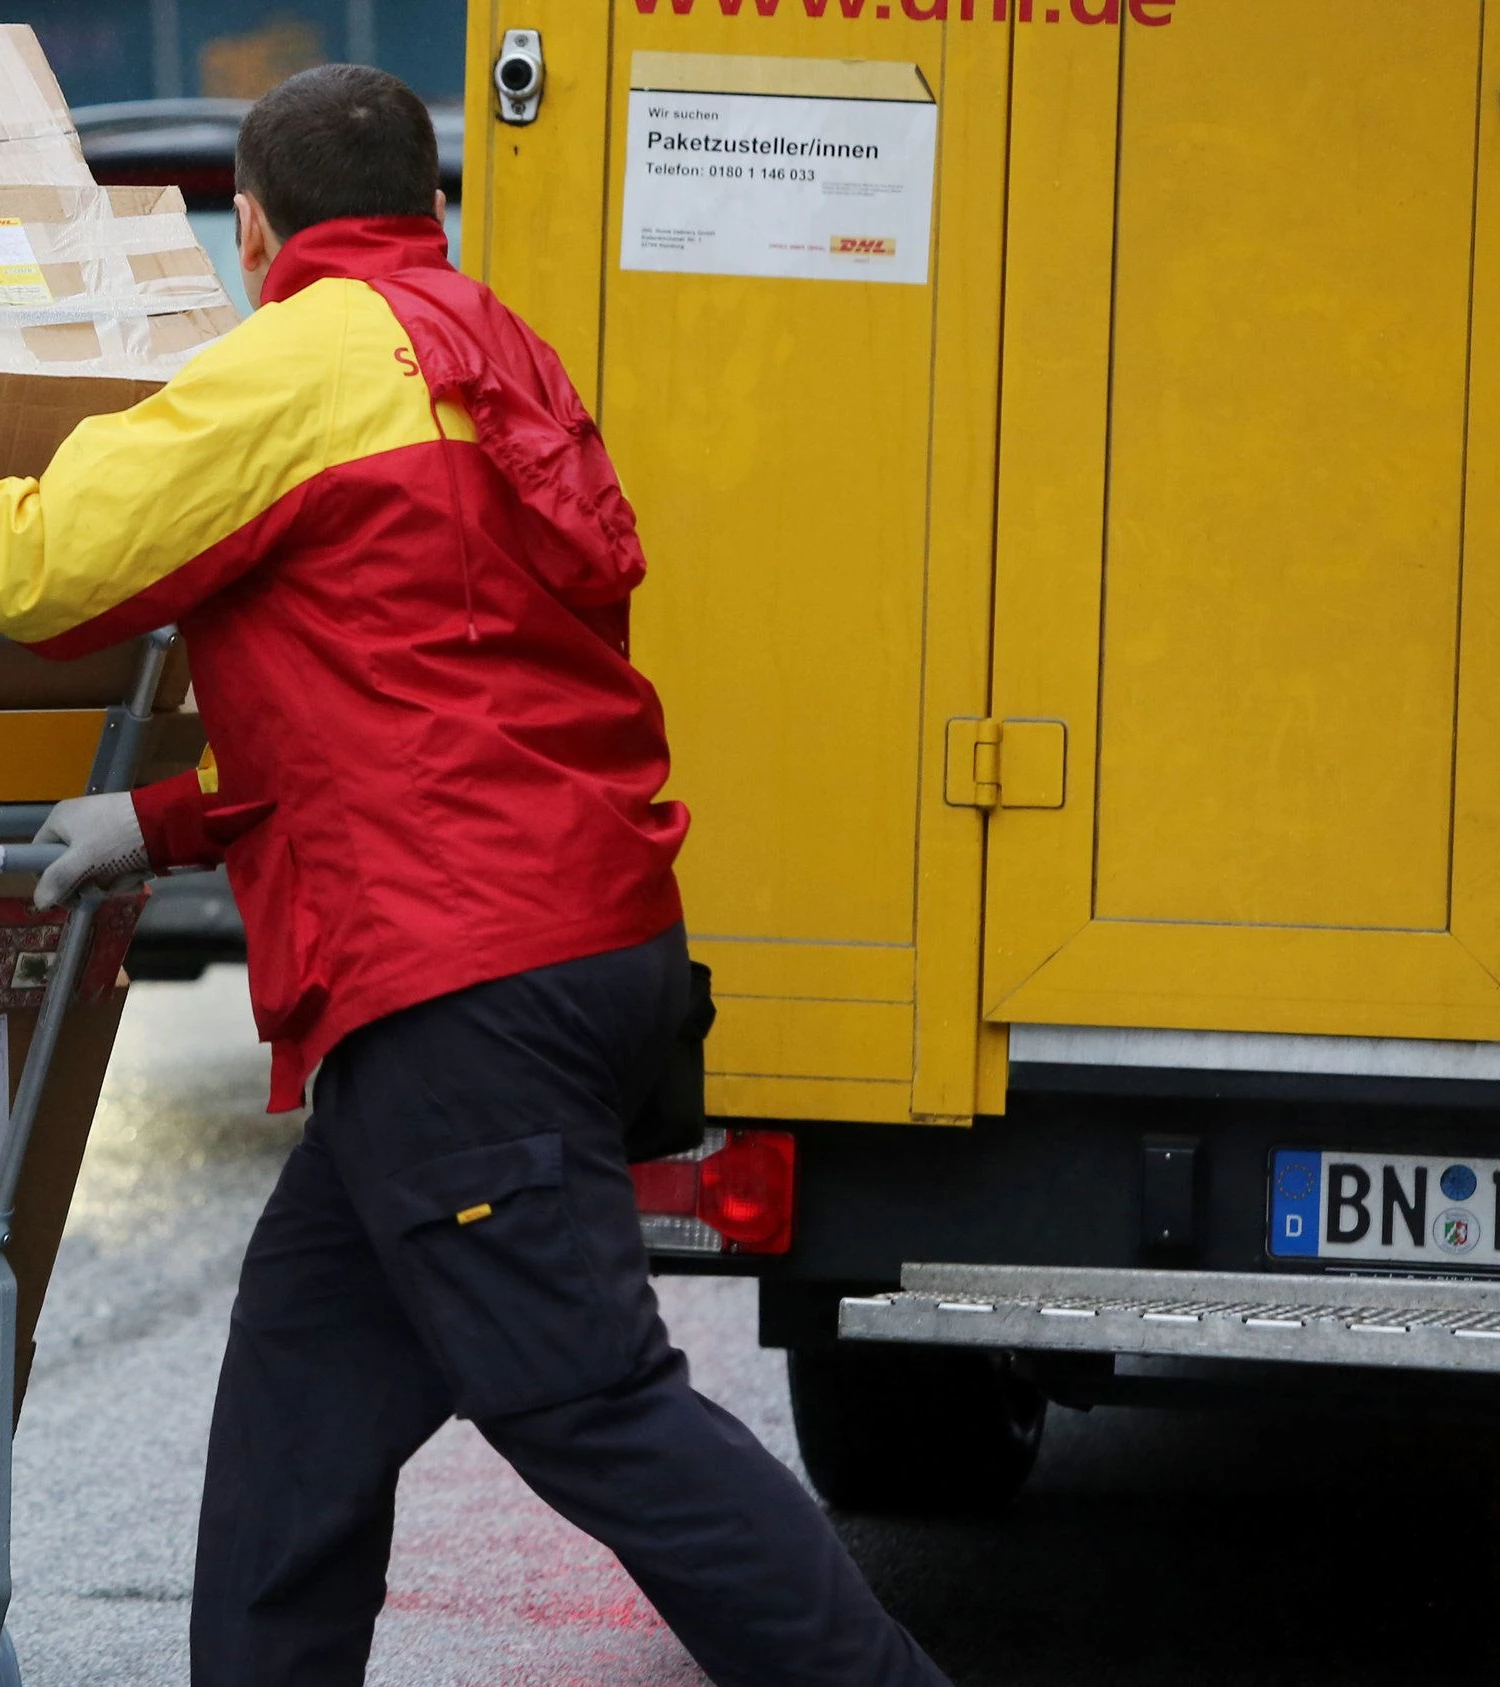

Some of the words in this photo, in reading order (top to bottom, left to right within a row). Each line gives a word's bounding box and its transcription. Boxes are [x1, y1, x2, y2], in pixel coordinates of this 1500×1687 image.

[648, 107, 669, 118] Wir
[673, 109, 719, 120] suchen
[647, 131, 879, 159] Paketzusteller/innen
[647, 162, 704, 176] Telefon:
[709, 165, 743, 178] 0180
[748, 167, 754, 178] 1
[762, 168, 785, 180] 146
[790, 169, 815, 181] 033
[839, 239, 885, 253] DHL
[394, 348, 419, 376] S
[1326, 1163, 1428, 1247] BN
[1285, 1214, 1303, 1238] D
